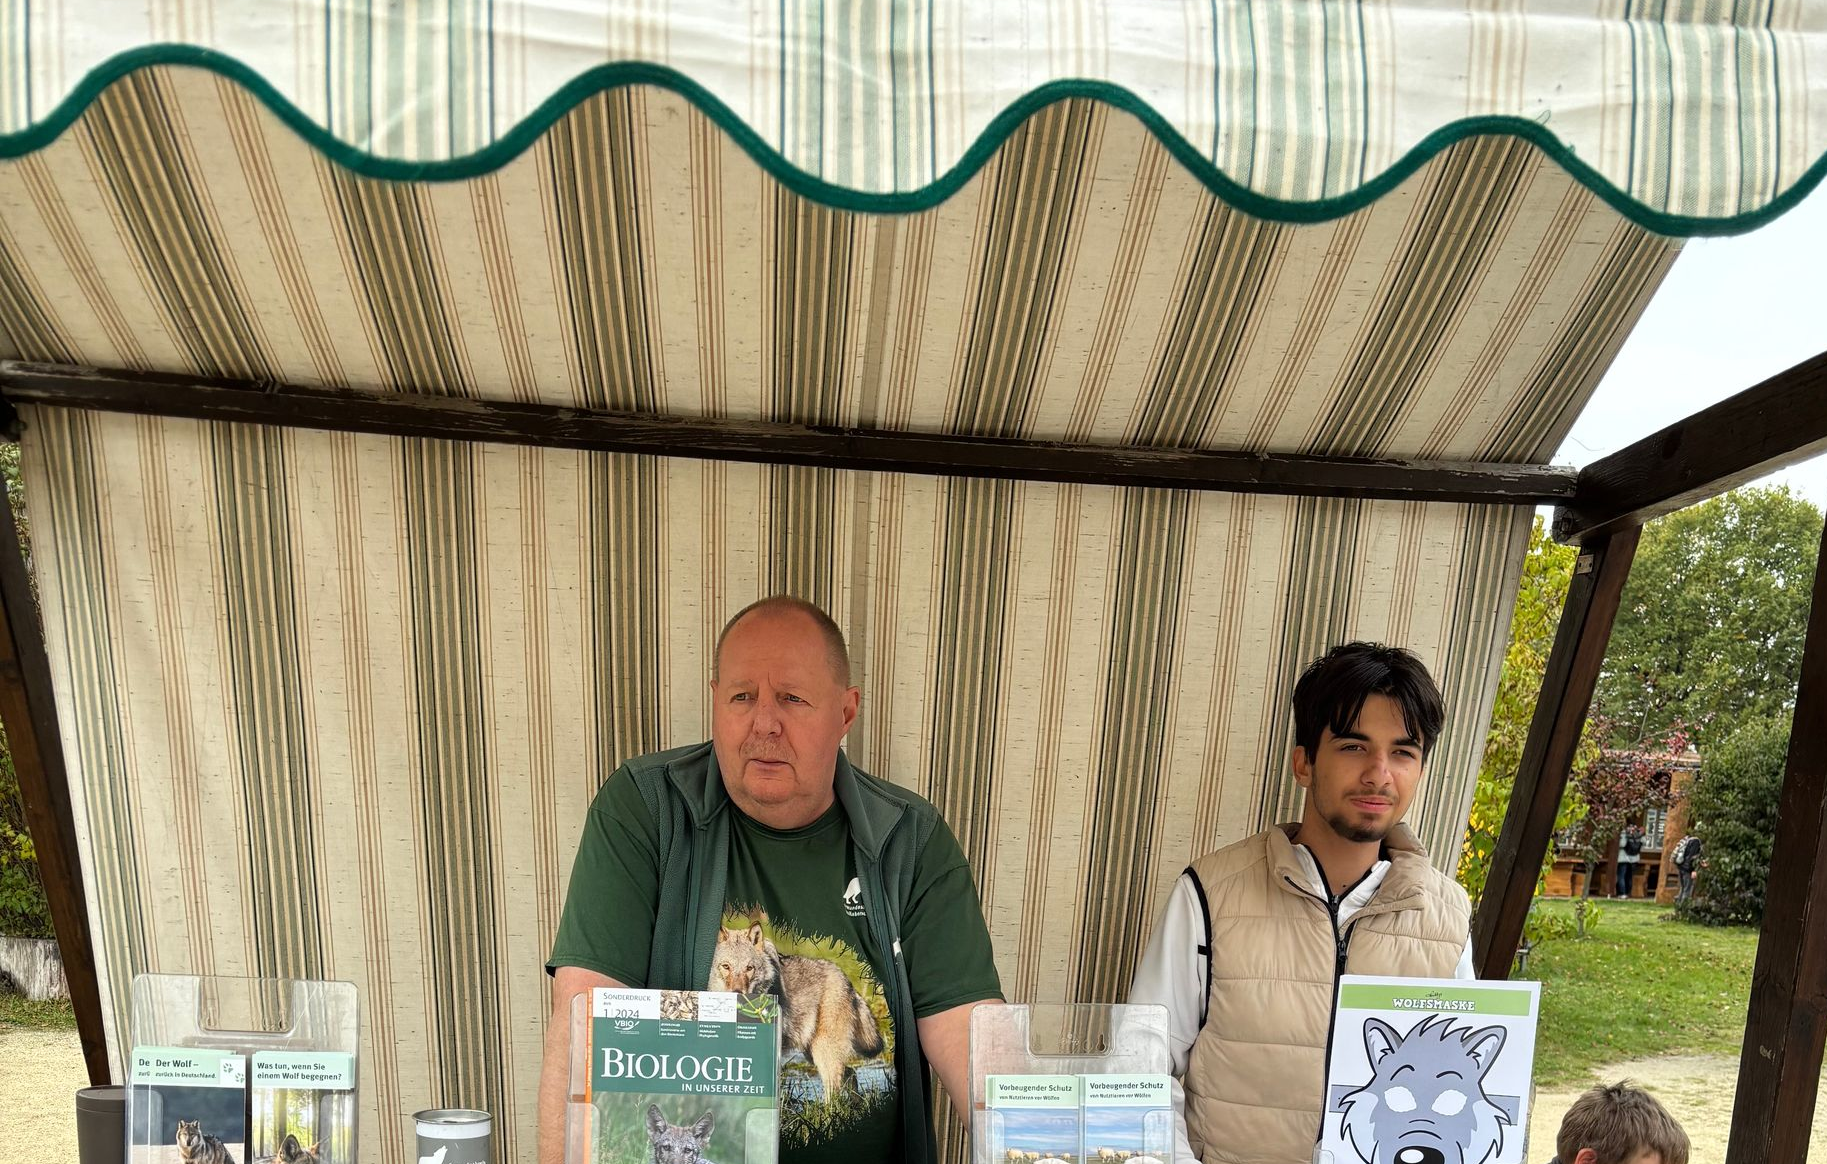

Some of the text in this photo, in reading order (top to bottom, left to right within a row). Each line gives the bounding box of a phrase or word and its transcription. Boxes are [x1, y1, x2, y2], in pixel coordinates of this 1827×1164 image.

[1392, 998, 1475, 1011] WOLFSMASKE
[604, 1008, 608, 1019] 1
[615, 1009, 640, 1019] 2024
[138, 1058, 150, 1066] De
[155, 1059, 170, 1067] Der
[172, 1060, 192, 1068] Wolf
[257, 1062, 326, 1071] Was tun, wenn Sie
[600, 1047, 754, 1082] BIOLOGIE
[257, 1071, 342, 1082] einem Wolf begegnen?
[681, 1083, 765, 1094] IN UNSERER ZEIT
[999, 1084, 1073, 1092] Vorbeugender Schutz
[1089, 1081, 1164, 1090] Vorbeugender Schutz
